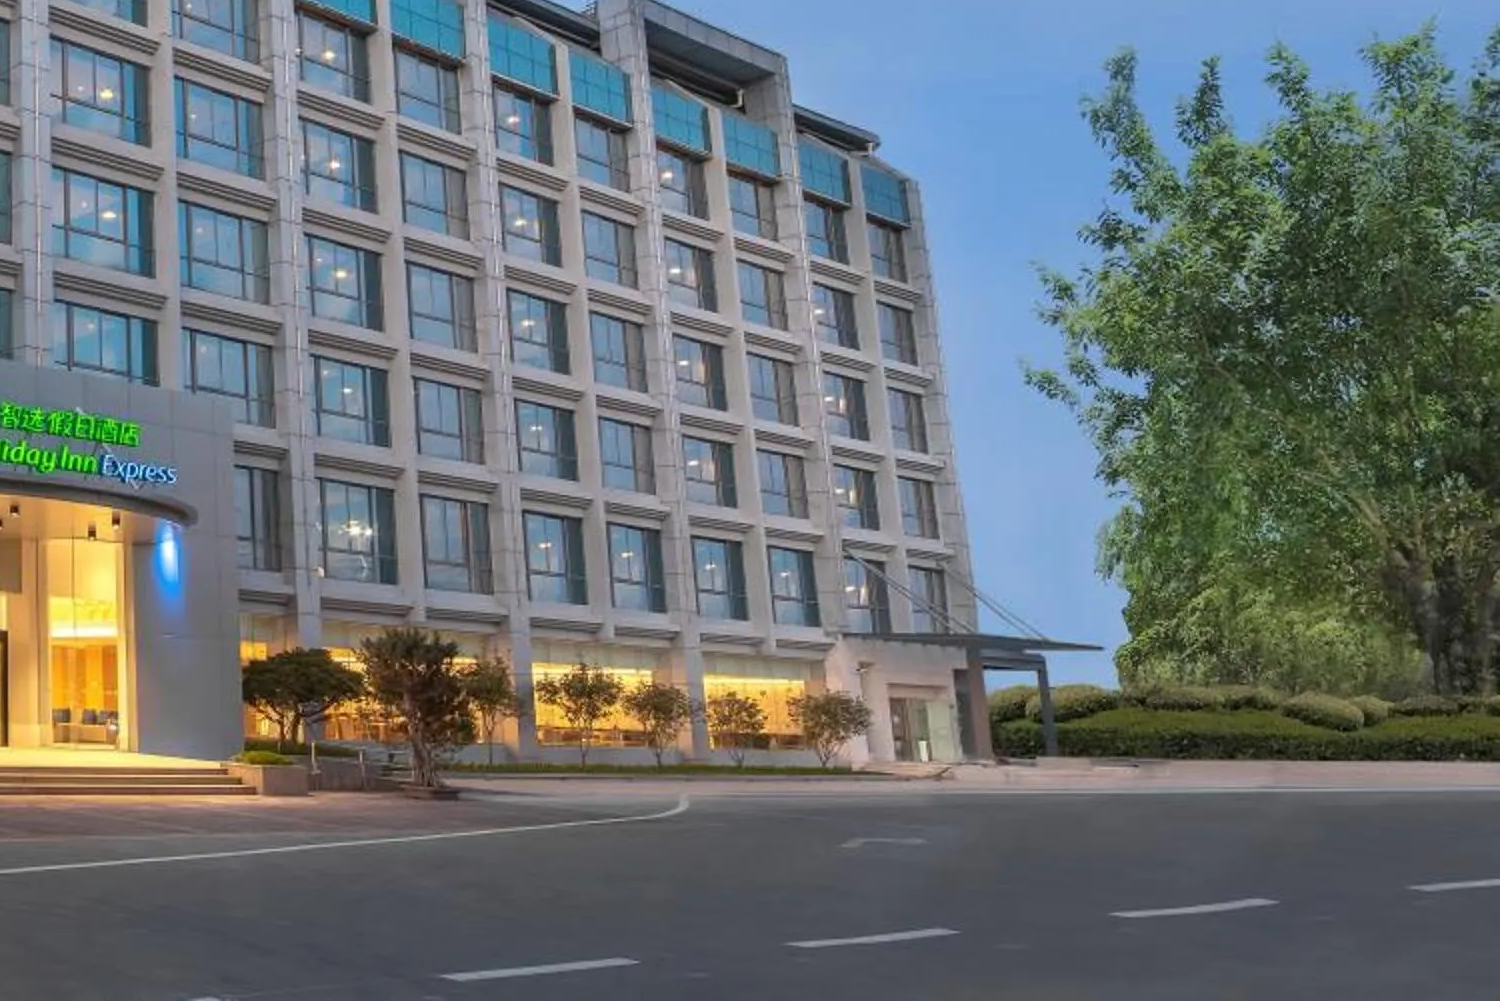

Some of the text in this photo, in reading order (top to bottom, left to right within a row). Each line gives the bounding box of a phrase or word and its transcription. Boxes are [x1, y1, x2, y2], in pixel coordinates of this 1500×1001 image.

[0, 402, 141, 446] 智选假日酒店
[60, 445, 99, 474] Inn
[101, 453, 179, 486] Express
